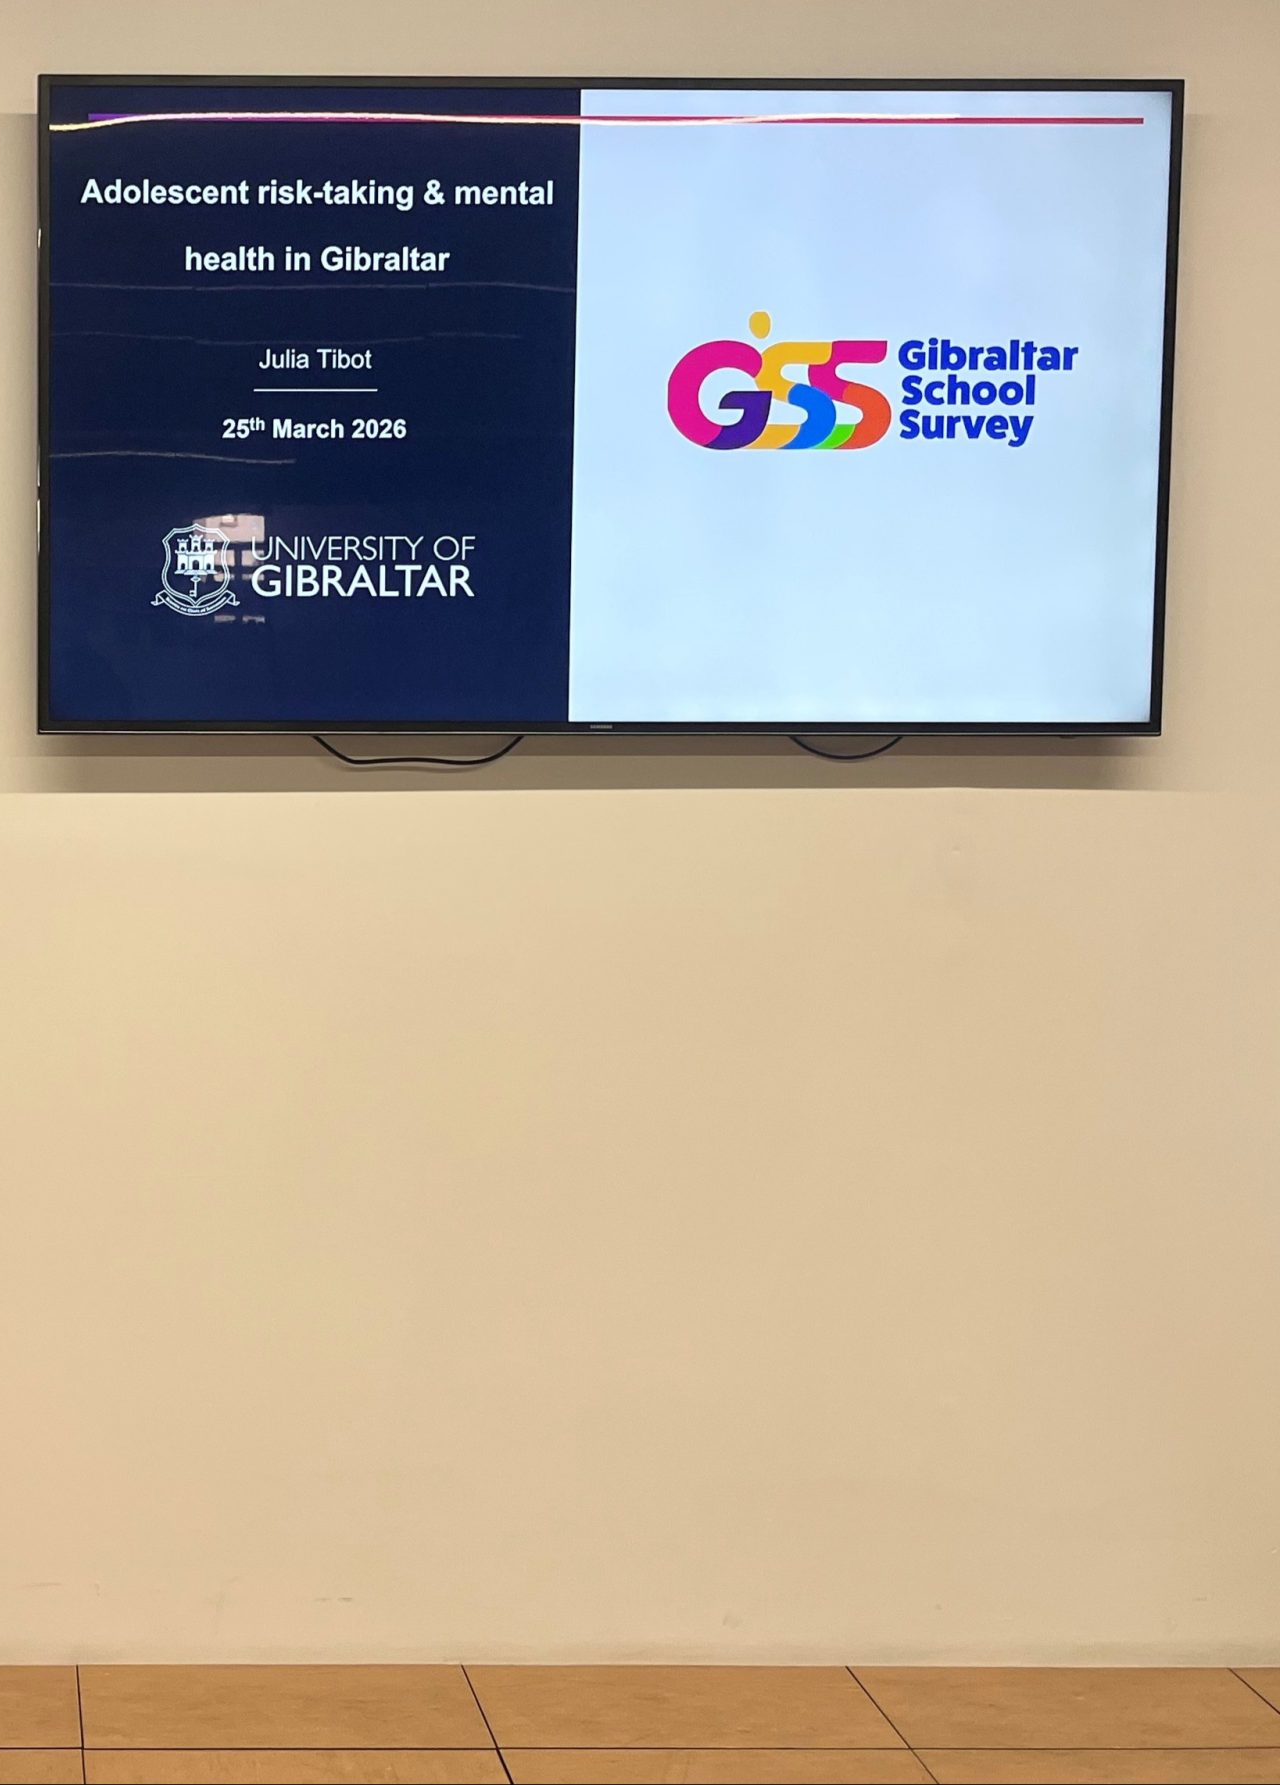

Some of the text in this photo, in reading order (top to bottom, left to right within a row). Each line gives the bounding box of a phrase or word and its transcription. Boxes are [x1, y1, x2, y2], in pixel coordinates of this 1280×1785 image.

[81, 179, 555, 211] Adolescent risk-taking & mental
[185, 246, 450, 272] health in Gibraltar
[259, 349, 372, 369] Julia Tibot
[898, 338, 1079, 371] Gibraltar
[901, 374, 1036, 406] School
[222, 417, 407, 439] 25th March 2026
[899, 409, 1034, 448] Survey
[251, 536, 476, 561] UNIVERSITY OF
[251, 564, 475, 598] GIBRALTAR
